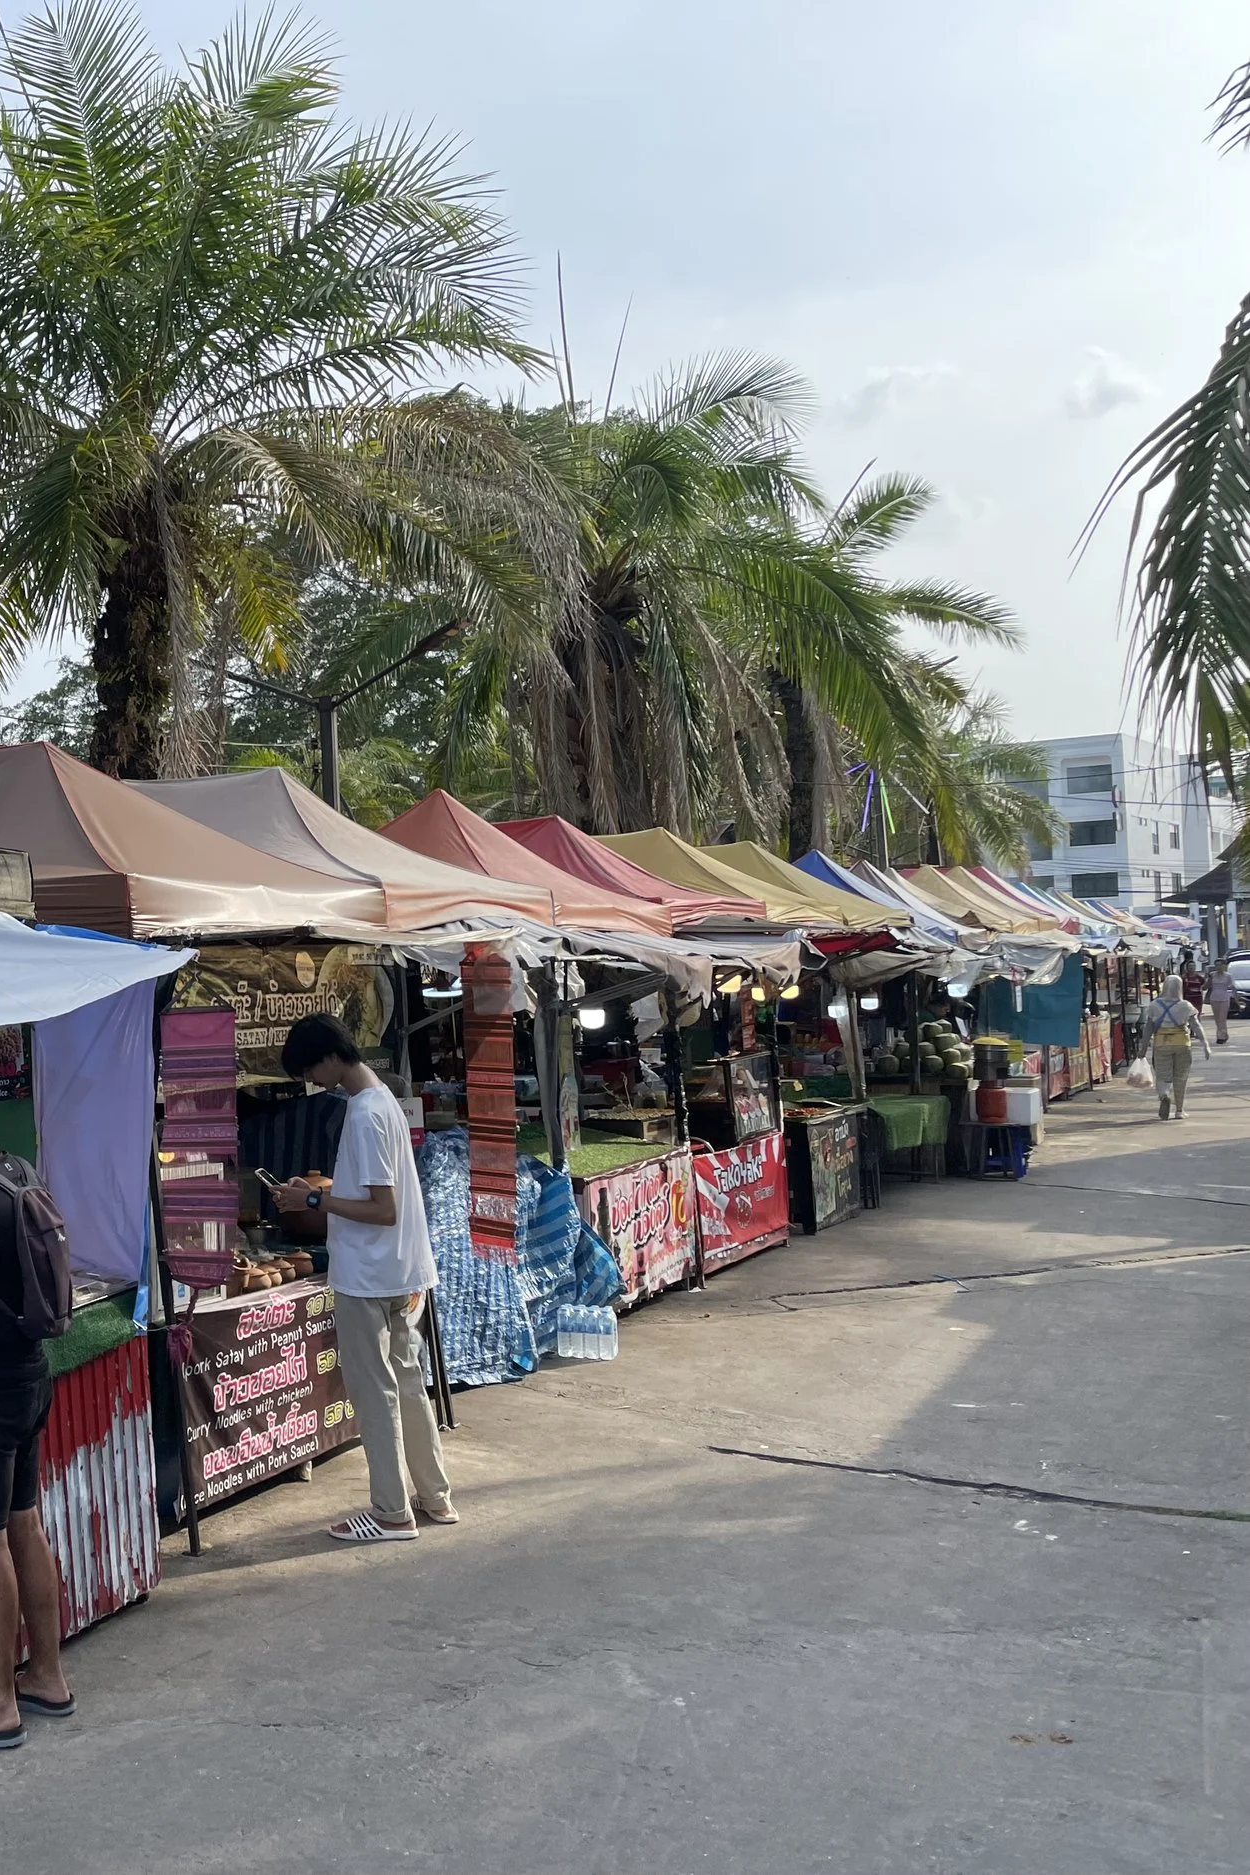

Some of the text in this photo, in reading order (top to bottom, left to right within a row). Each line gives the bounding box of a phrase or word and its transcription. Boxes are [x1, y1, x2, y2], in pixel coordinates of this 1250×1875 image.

[236, 1029, 267, 1047] SATAY
[306, 1295, 324, 1318] 10
[215, 1348, 244, 1368] Satay
[247, 1338, 268, 1358] with
[271, 1326, 303, 1350] Peanut
[215, 1408, 252, 1430] Noodles
[255, 1398, 275, 1416] with
[277, 1381, 314, 1407] chicken)
[207, 1474, 243, 1499] Noodles
[246, 1463, 266, 1481] with
[268, 1450, 288, 1472] Pork
[290, 1436, 319, 1460] Sauce)
